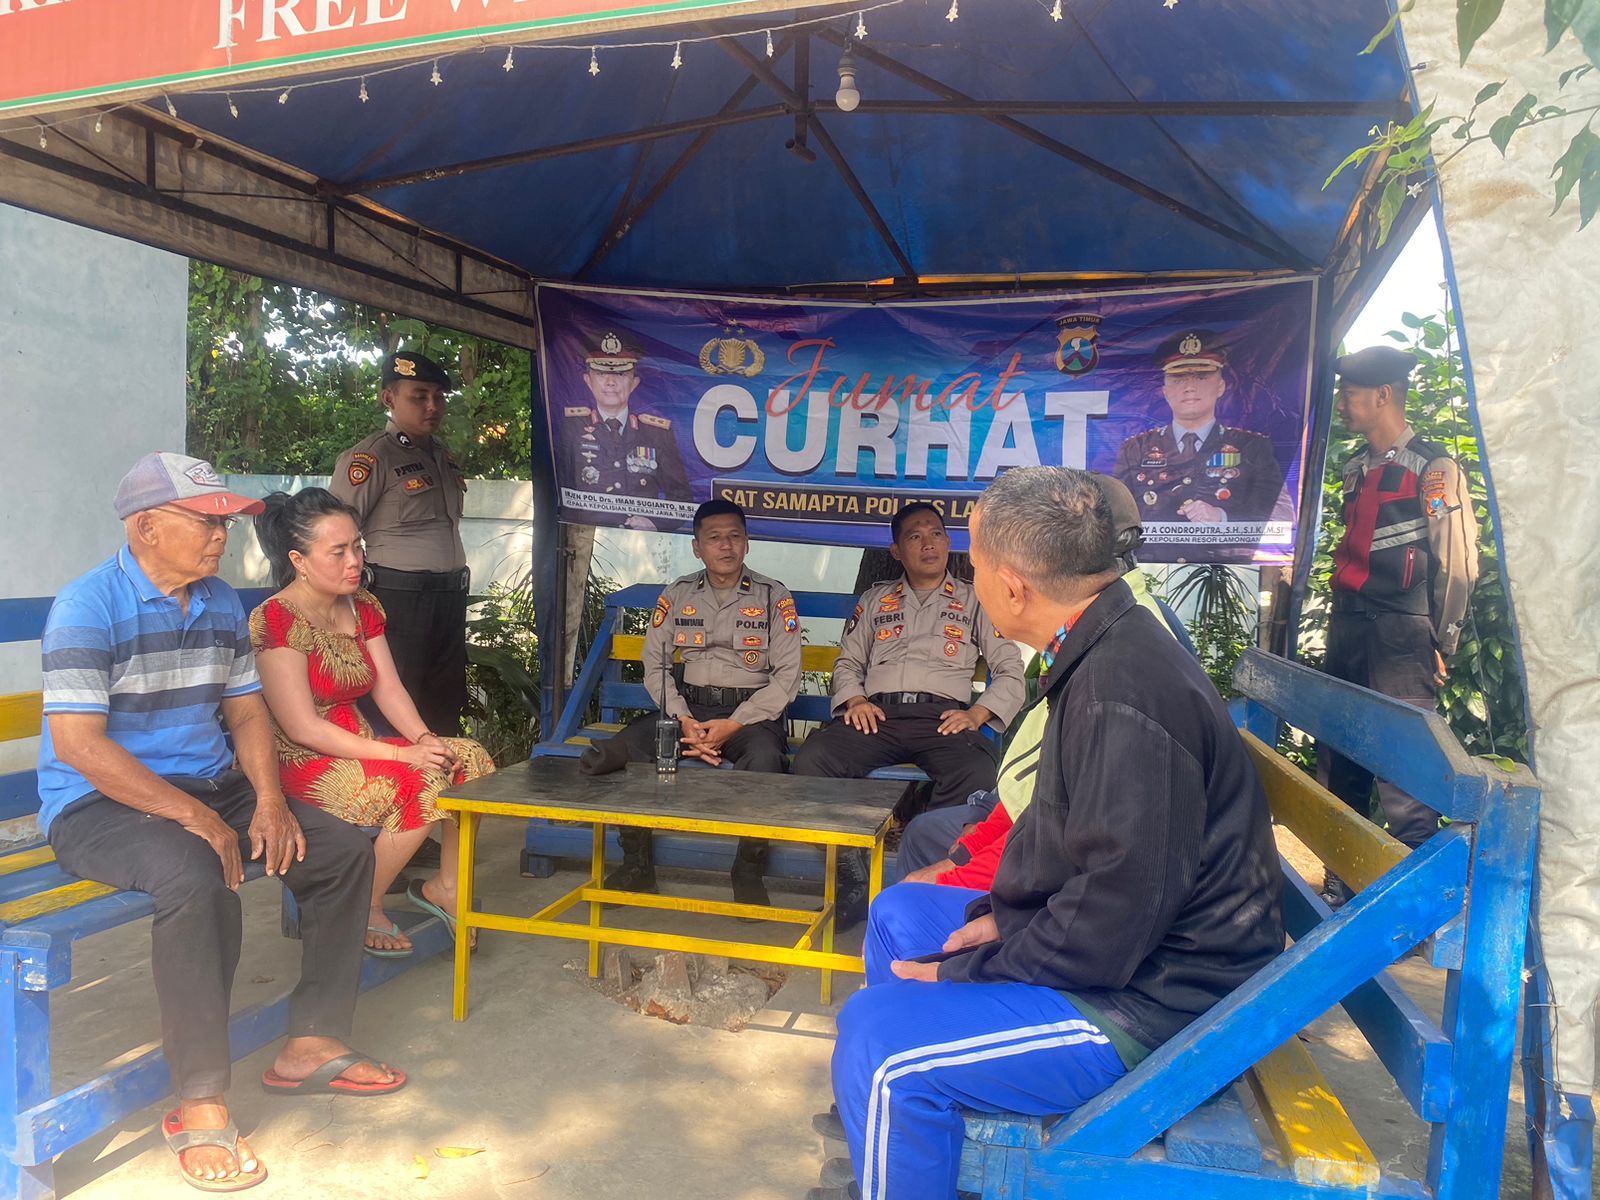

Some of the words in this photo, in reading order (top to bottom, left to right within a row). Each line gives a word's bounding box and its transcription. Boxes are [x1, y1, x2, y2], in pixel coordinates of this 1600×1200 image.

[764, 337, 1026, 417] Jumat
[693, 384, 1110, 481] CURHAT
[583, 494, 598, 502] POL
[721, 488, 758, 508] SAT
[762, 491, 860, 513] SAMAPTA
[865, 496, 945, 517] POLS
[735, 619, 769, 631] POLRI
[873, 612, 905, 627] FEBRI
[939, 611, 972, 627] POLRI
